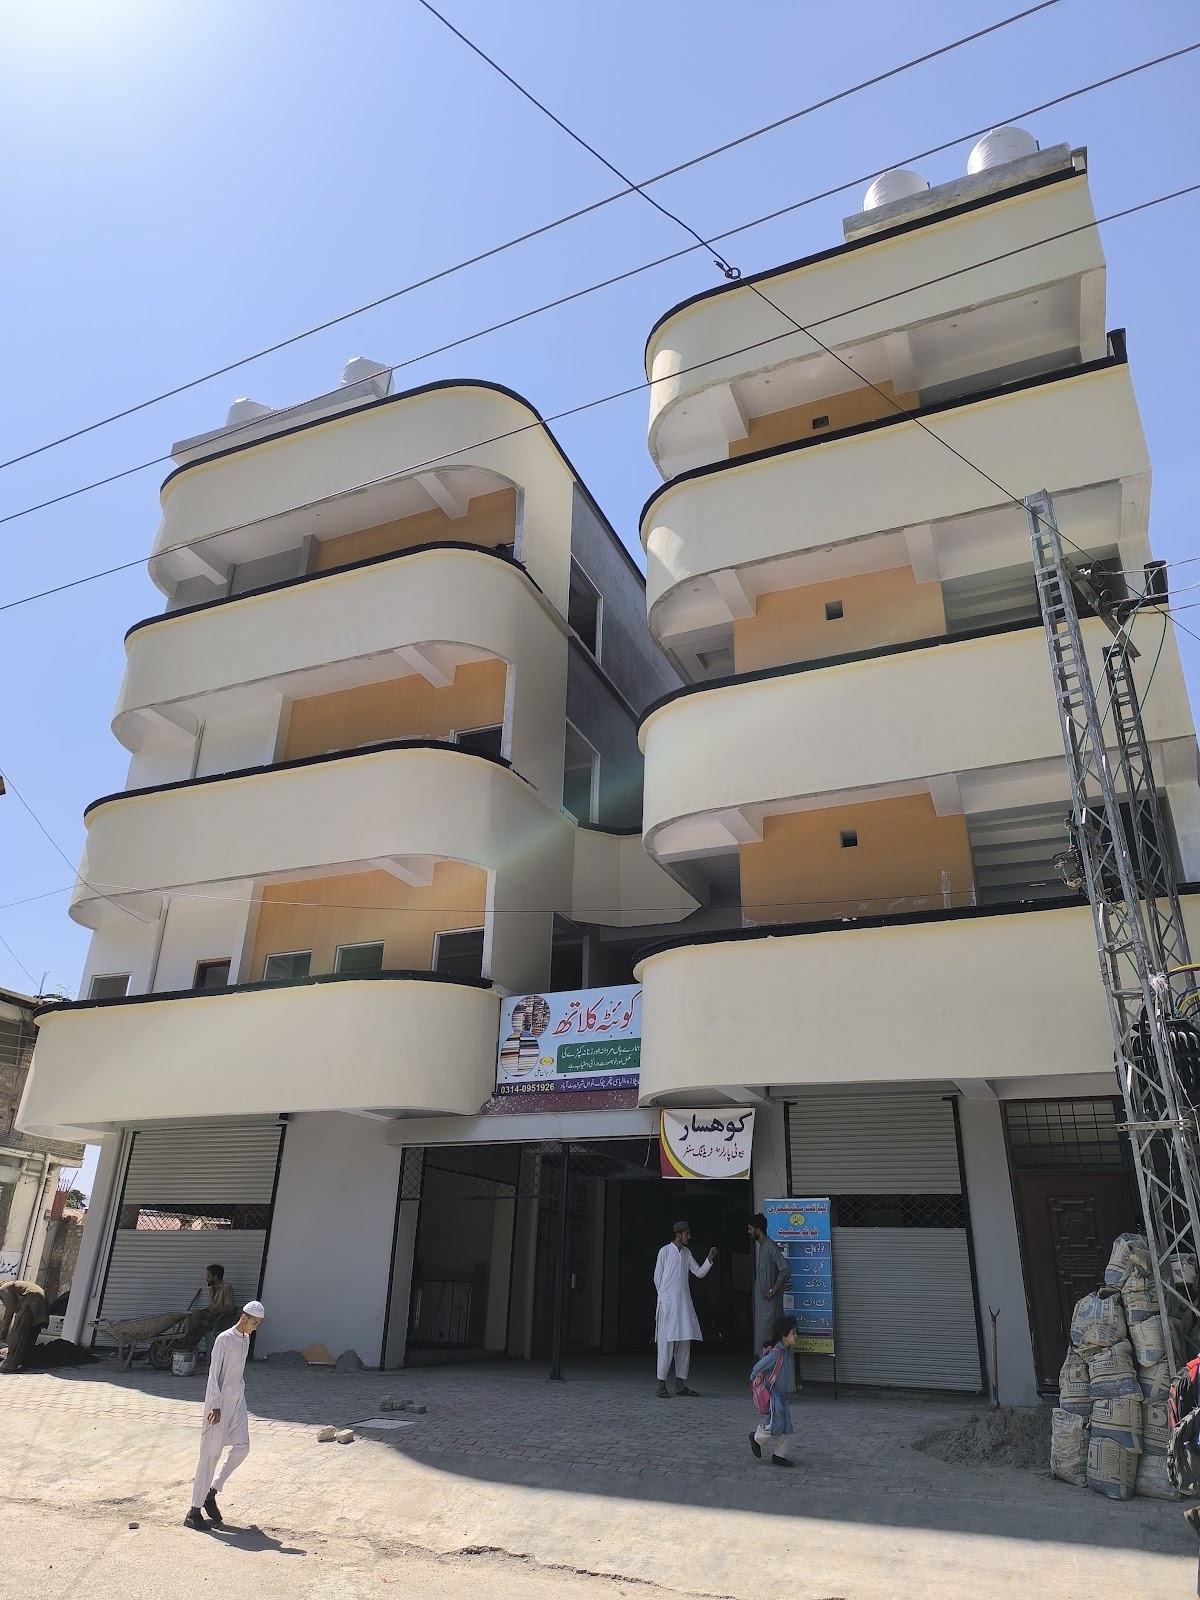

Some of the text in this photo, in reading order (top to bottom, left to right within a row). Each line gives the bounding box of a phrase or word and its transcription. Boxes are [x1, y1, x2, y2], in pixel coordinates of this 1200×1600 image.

[552, 996, 604, 1035] کلاتھ
[500, 1083, 555, 1094] 0314-0951926
[719, 1145, 731, 1161] پارلر
[731, 1142, 745, 1158] بیوٹی
